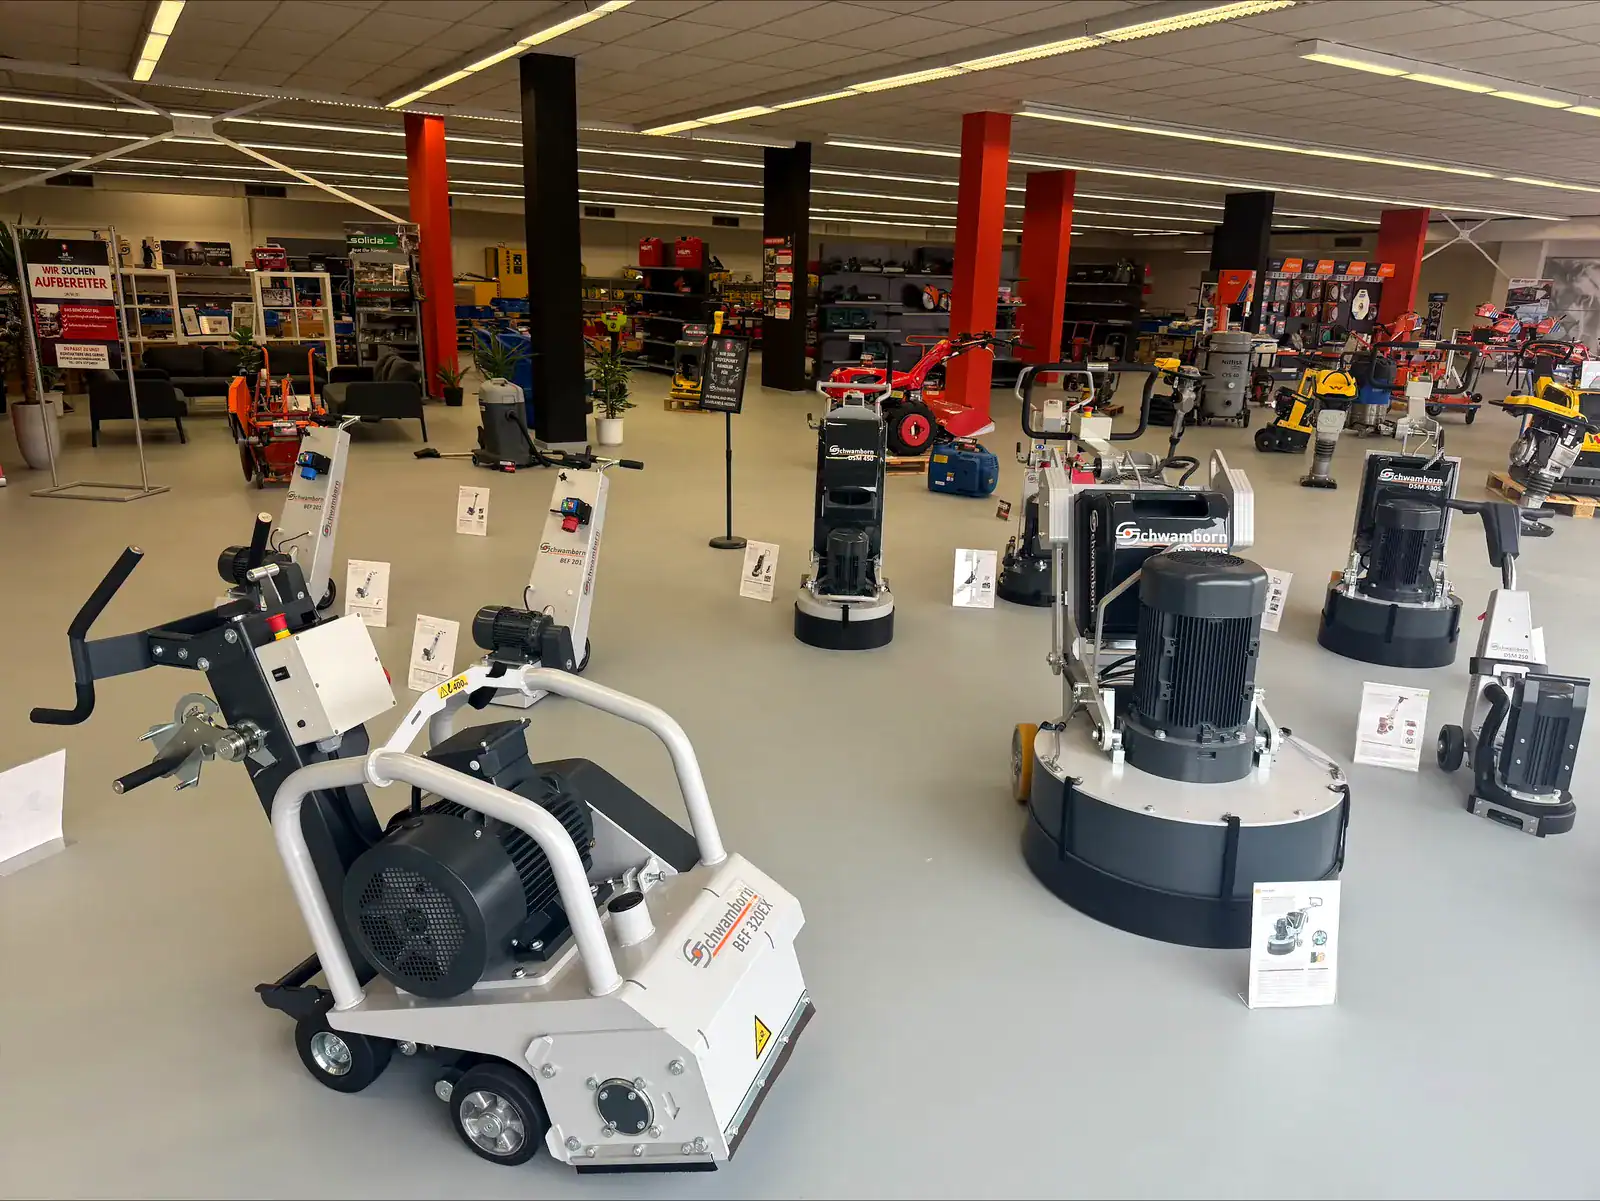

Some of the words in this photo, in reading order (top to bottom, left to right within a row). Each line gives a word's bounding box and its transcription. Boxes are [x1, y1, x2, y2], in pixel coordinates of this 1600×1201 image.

[42, 266, 60, 275] WIR
[61, 266, 96, 276] SUCHEN
[35, 277, 108, 289] AUFBEREITER
[829, 444, 875, 456] Schwamborn
[1379, 468, 1444, 486] Schwamborn
[287, 490, 325, 502] Schwamborn
[321, 480, 340, 537] Schwamborn
[1115, 521, 1228, 544] Schwamborn
[540, 542, 586, 556] Schwamborn
[571, 558, 582, 566] 201
[583, 531, 601, 596] Schwamborn
[1090, 509, 1099, 612] Schwamborn
[454, 680, 465, 690] 400
[683, 887, 755, 968] Schwamborn
[732, 928, 751, 953] BEF
[746, 898, 774, 932] 320EX
